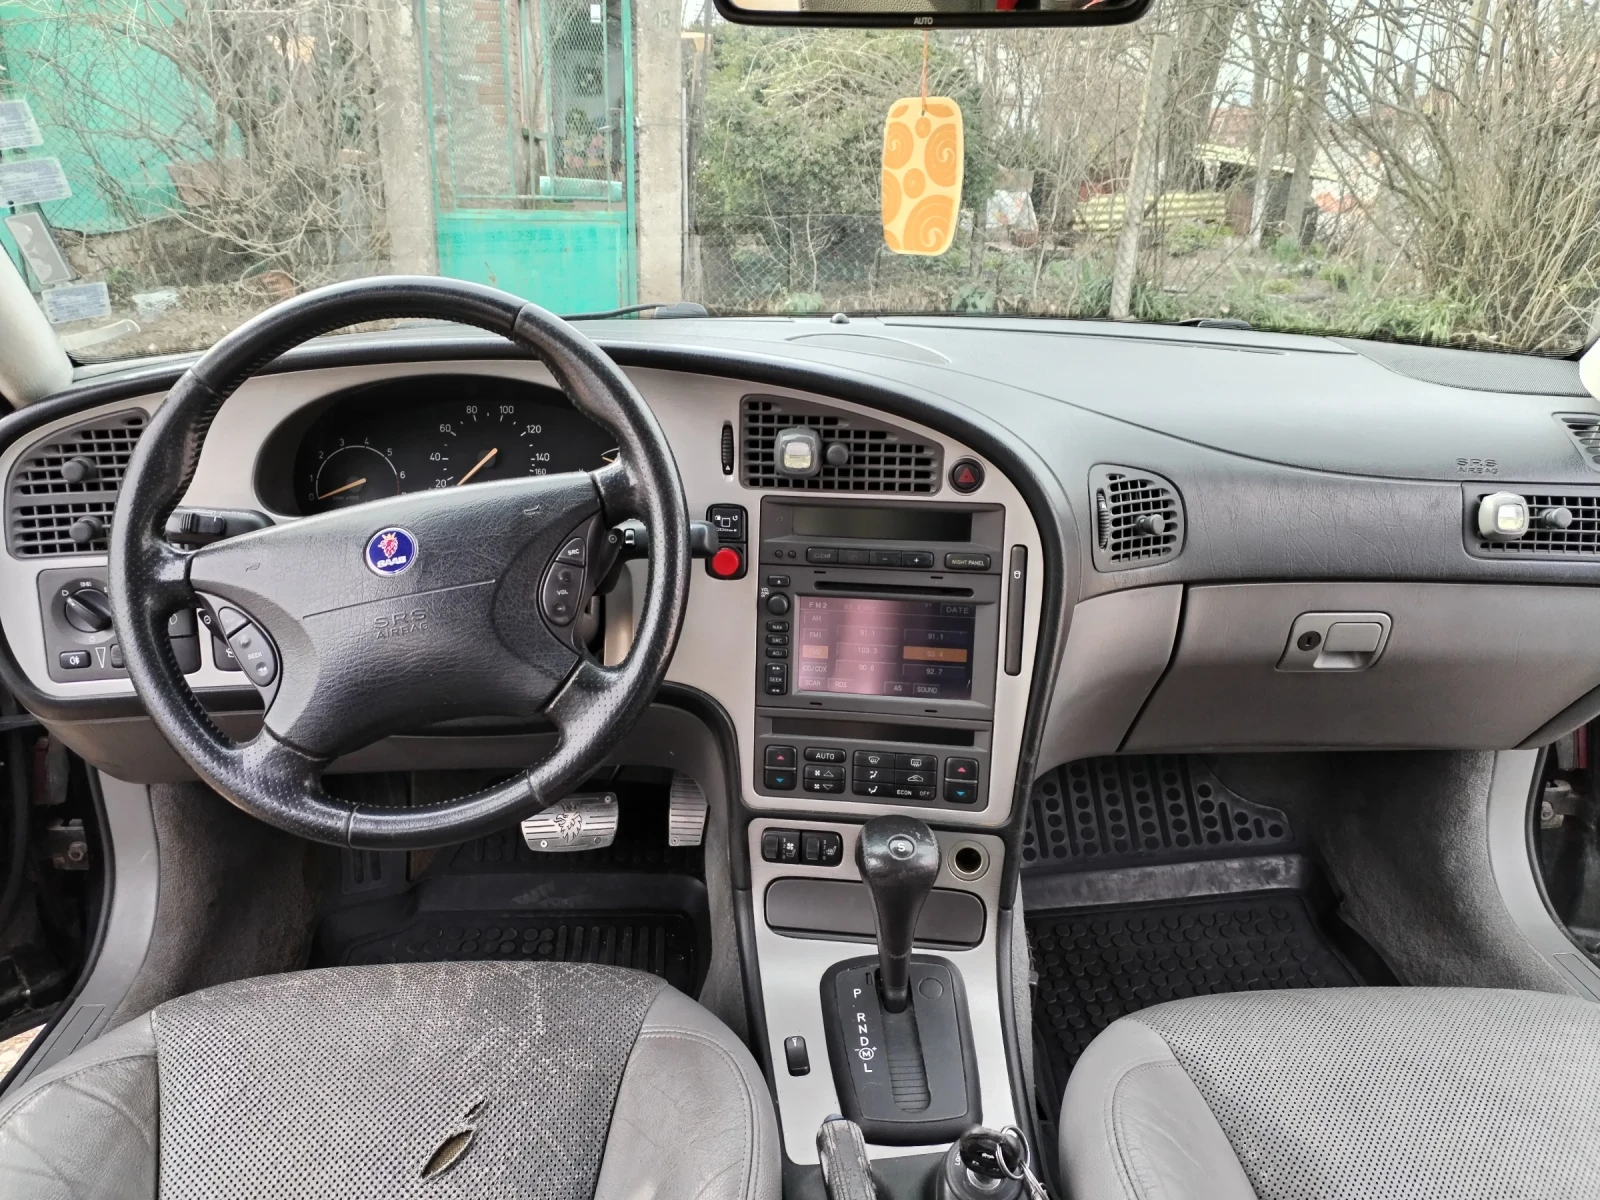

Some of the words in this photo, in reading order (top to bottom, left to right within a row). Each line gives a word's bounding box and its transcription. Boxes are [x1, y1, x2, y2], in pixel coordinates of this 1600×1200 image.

[652, 9, 671, 28] 13
[913, 16, 934, 25] AUTO
[466, 405, 478, 414] 80
[499, 405, 514, 414] 100
[439, 423, 452, 433] 60
[526, 424, 542, 434] 120
[340, 438, 345, 447] 3
[318, 451, 324, 459] 2
[387, 448, 393, 456] 5
[429, 452, 441, 461] 40
[535, 453, 550, 461] 140
[1456, 457, 1498, 467] SRS
[400, 471, 406, 479] 6
[435, 479, 447, 488] 20
[376, 555, 407, 569] SAAB
[808, 601, 828, 609] FM2
[946, 606, 969, 614] DATE
[374, 608, 428, 629] SRS
[376, 621, 429, 640] AIRBAG
[809, 631, 822, 639] FM1
[857, 646, 878, 654] 103.3
[247, 651, 263, 660] SEEK
[893, 684, 903, 692] AS
[917, 686, 938, 694] SOUND
[815, 752, 835, 760] AUTO
[896, 788, 913, 796] ECON
[897, 842, 906, 852] S
[853, 988, 862, 999] P
[856, 1012, 866, 1023] R
[858, 1024, 868, 1034] N
[860, 1036, 869, 1046] D
[862, 1050, 871, 1058] M
[863, 1063, 873, 1073] L
